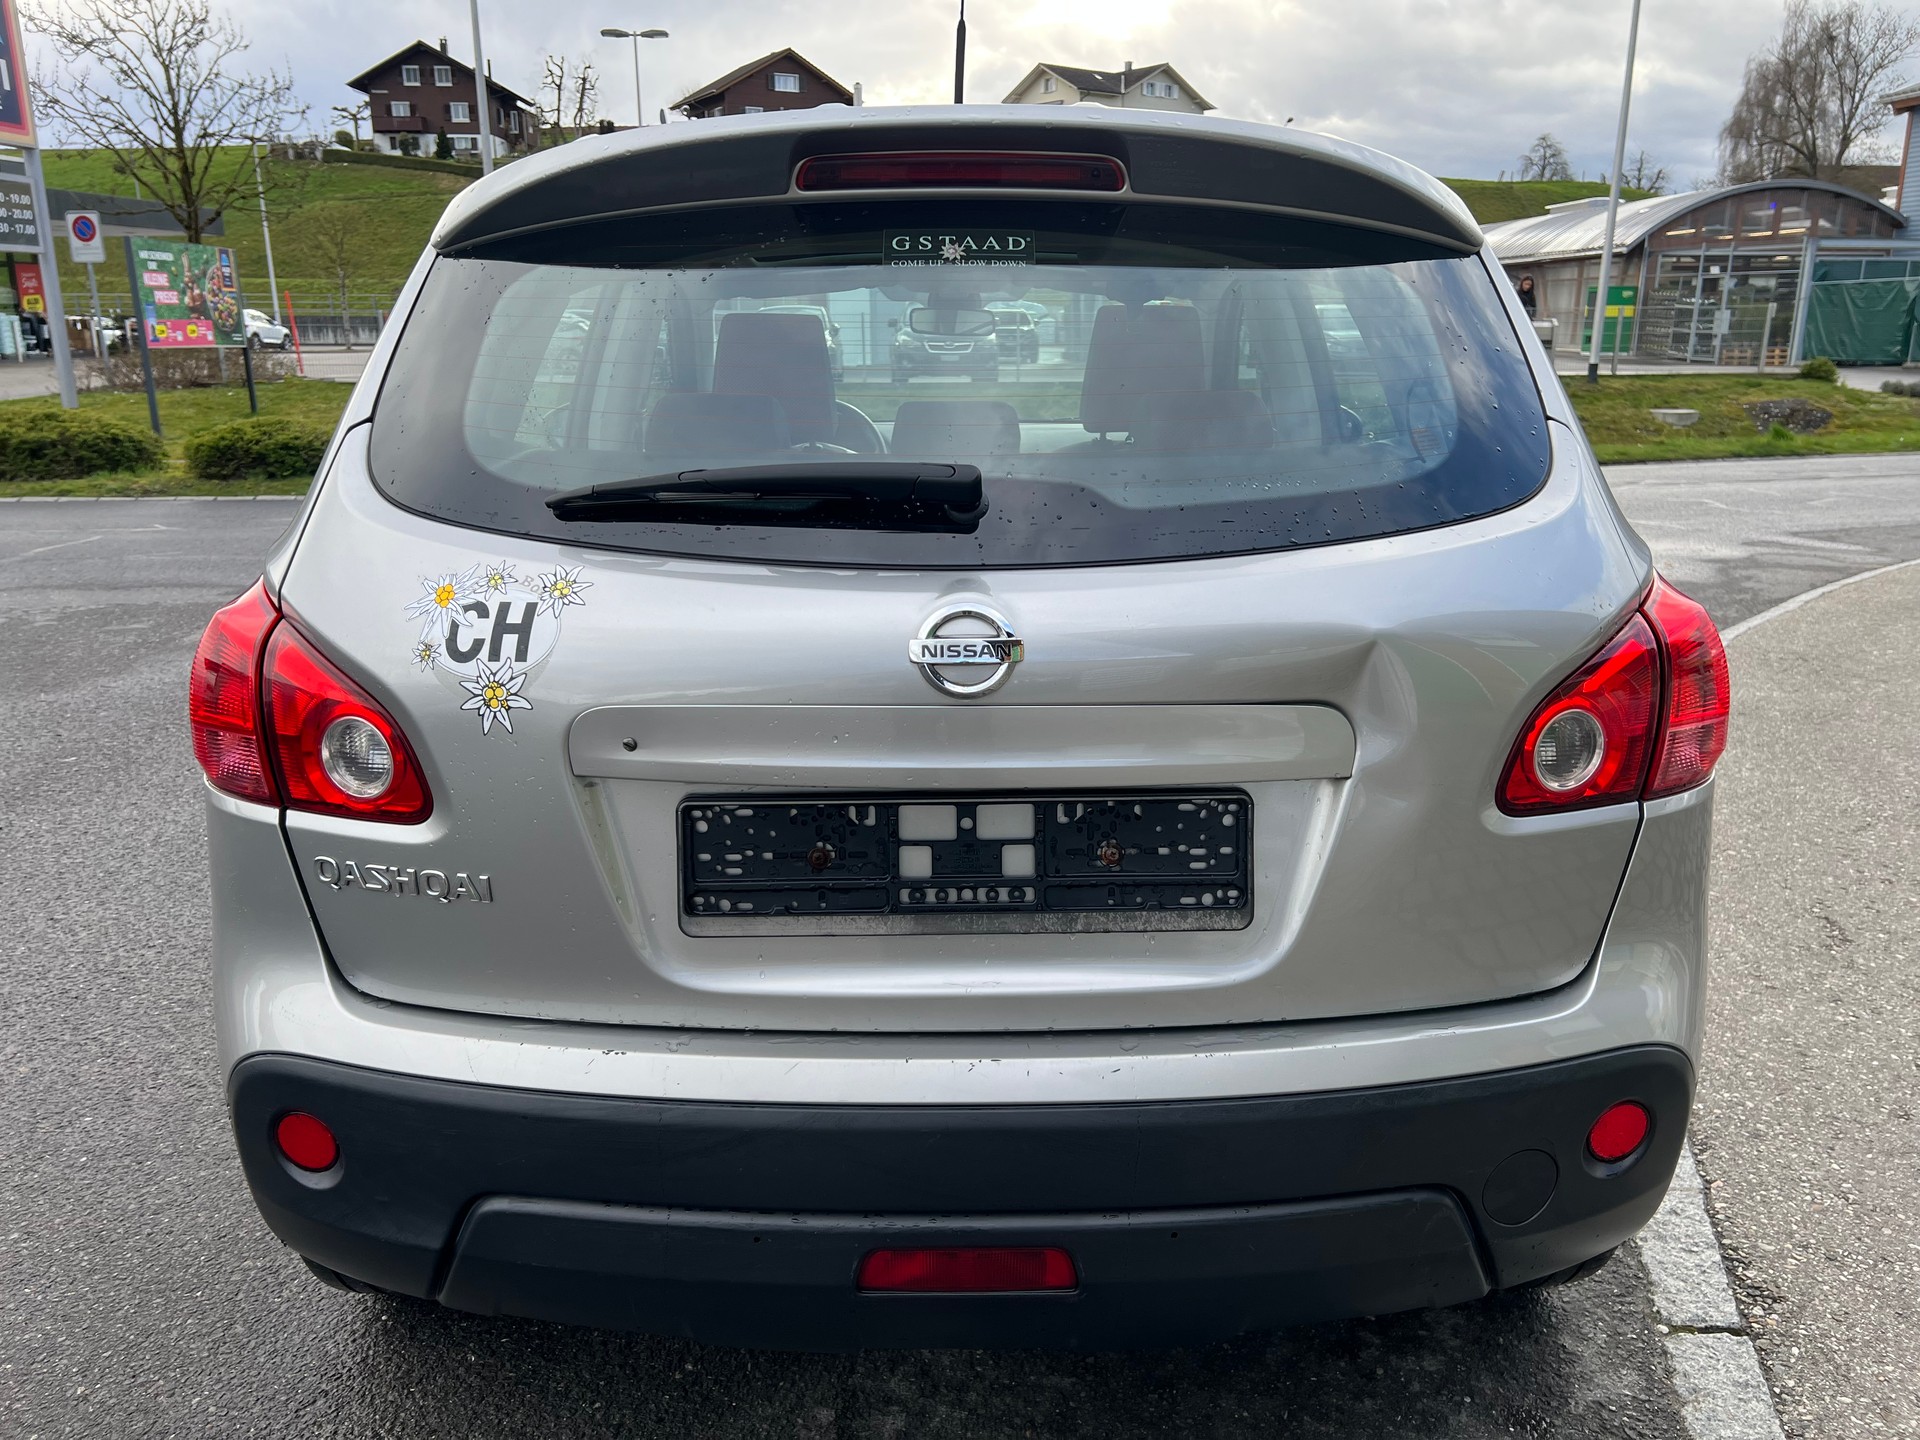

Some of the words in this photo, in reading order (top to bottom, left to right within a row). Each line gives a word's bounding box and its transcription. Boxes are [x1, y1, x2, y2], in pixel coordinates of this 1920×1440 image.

[10, 193, 31, 205] 19.00
[12, 208, 33, 220] 20.00
[15, 223, 36, 235] 17.00
[891, 259, 926, 268] COME
[929, 259, 945, 267] UP
[954, 259, 988, 267] SLOW
[991, 259, 1027, 268] DOWN
[445, 601, 539, 664] CH
[921, 644, 1012, 659] NISSAN
[313, 855, 493, 903] QASHQAI
